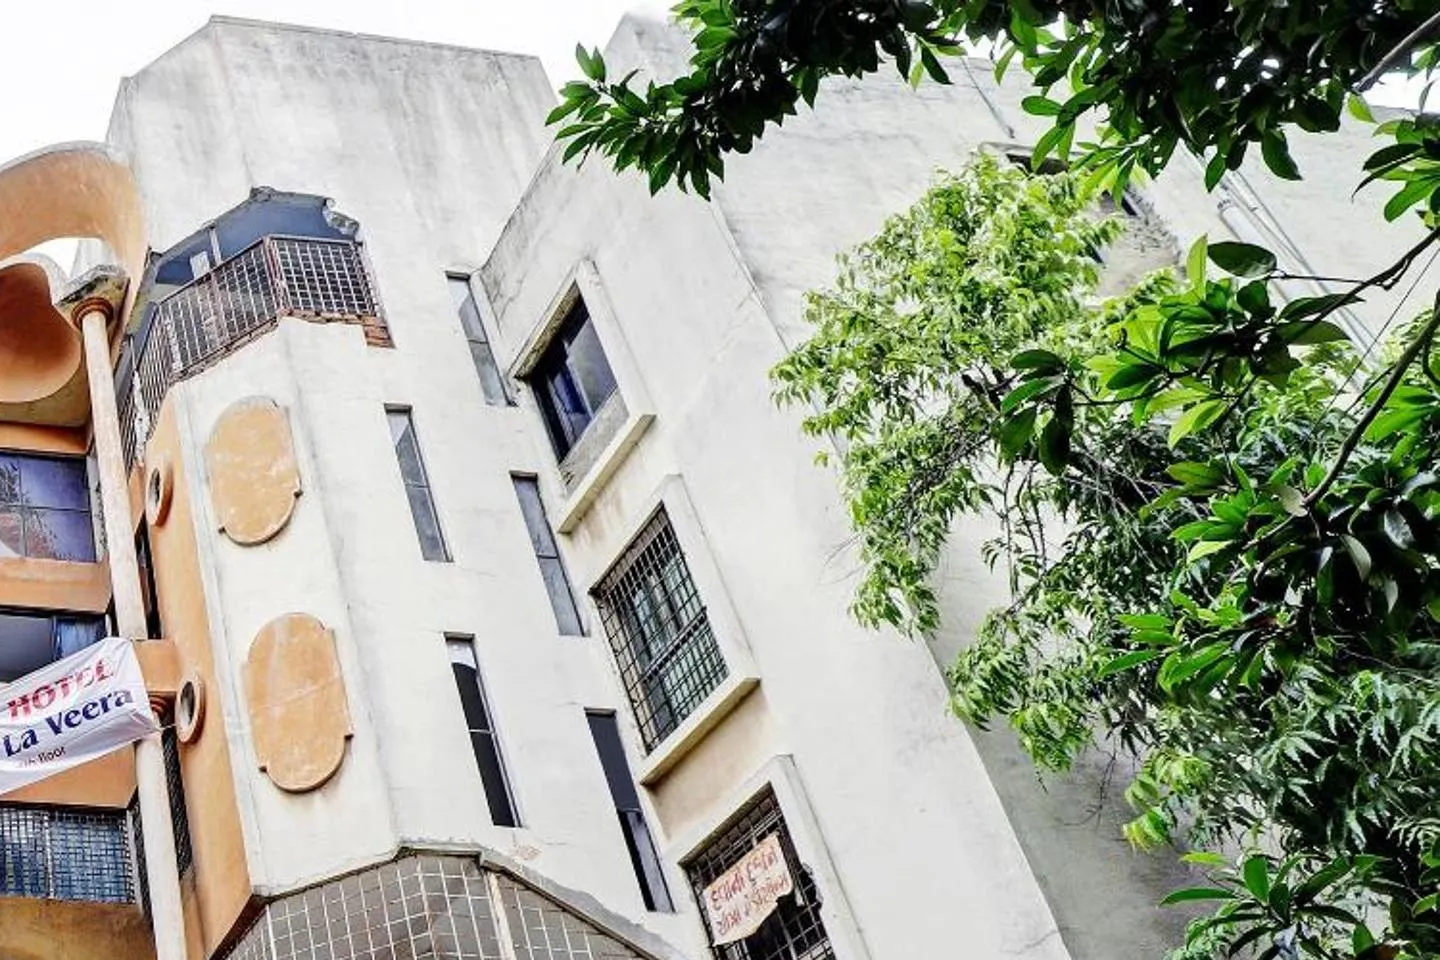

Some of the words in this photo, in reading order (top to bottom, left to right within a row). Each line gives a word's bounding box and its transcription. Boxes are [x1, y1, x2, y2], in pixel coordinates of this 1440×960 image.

[7, 658, 113, 719] HOTEL
[3, 727, 39, 757] La
[44, 690, 134, 735] Veera
